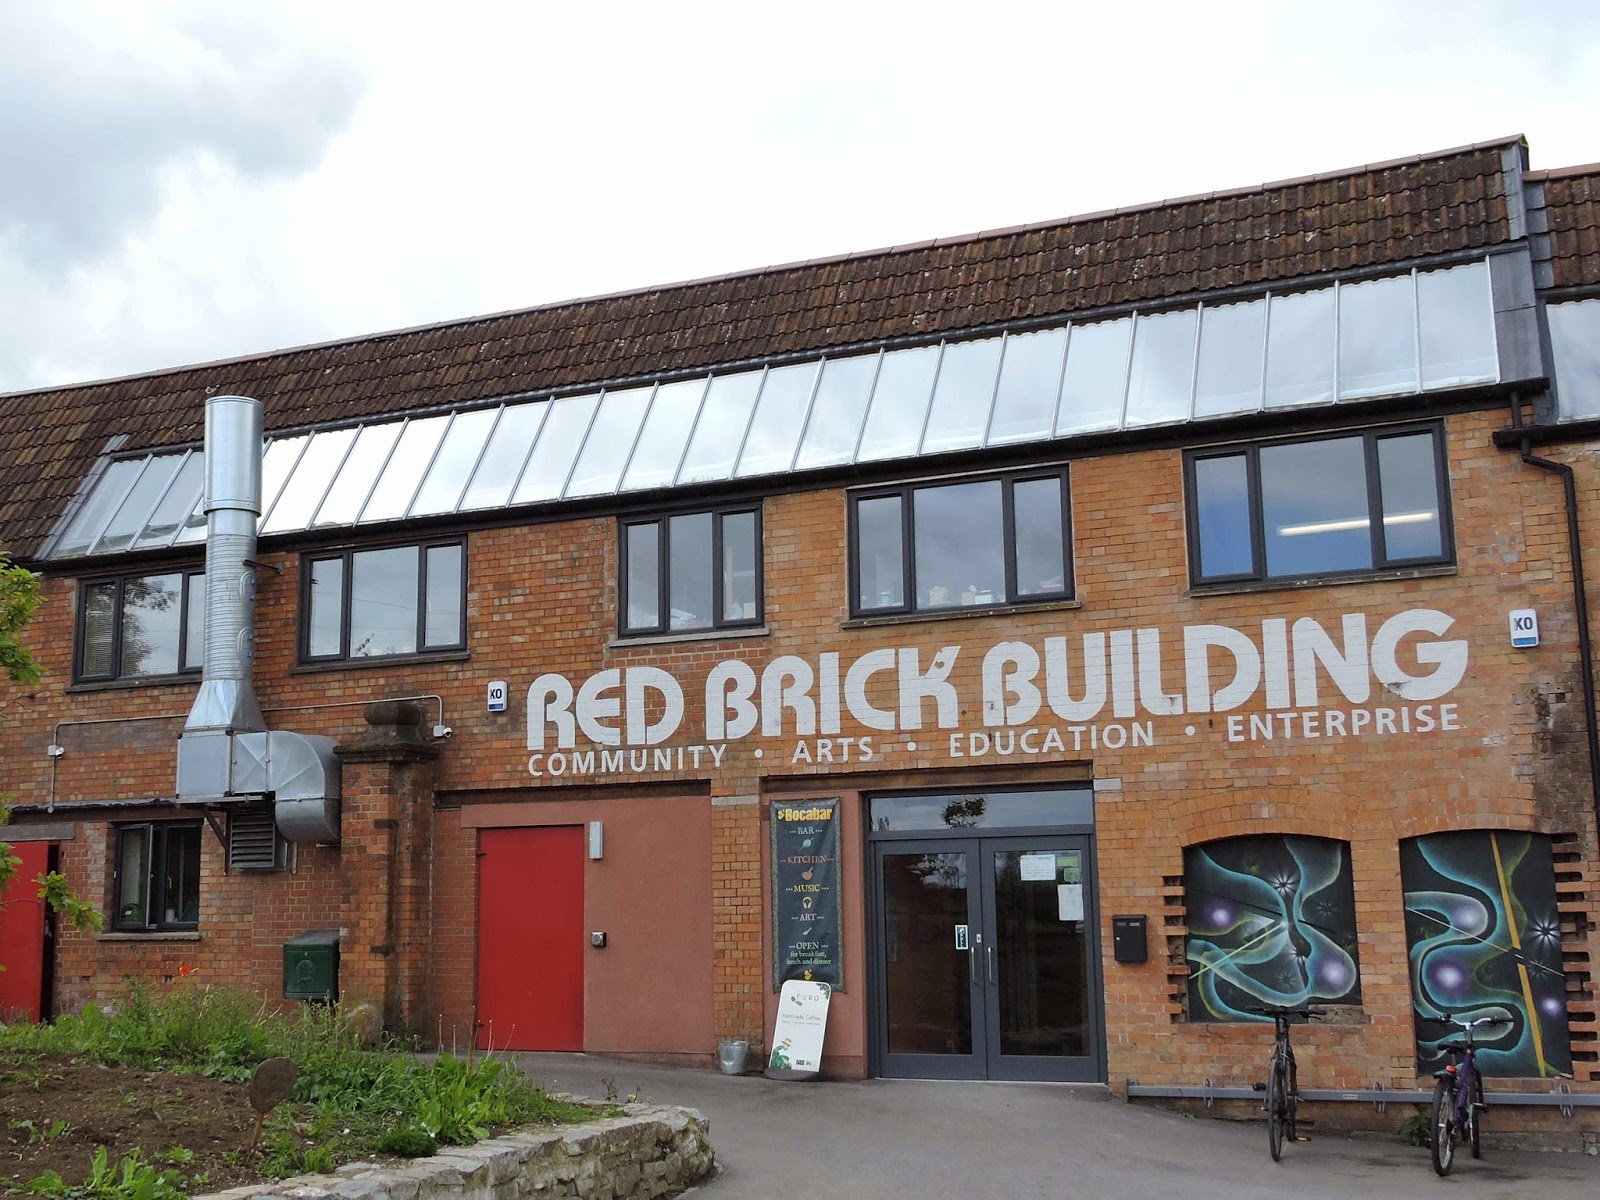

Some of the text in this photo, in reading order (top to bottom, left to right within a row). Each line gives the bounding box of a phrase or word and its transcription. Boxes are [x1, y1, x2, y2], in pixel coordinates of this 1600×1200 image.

[526, 609, 1469, 751] RED BRICK BUILDING
[528, 703, 1460, 777] COMMUNITY ARTS EDUCATION ENTERPRISE
[785, 807, 833, 822] Bocabar
[797, 826, 815, 835] BAR
[787, 855, 827, 864] KITCHEN
[793, 884, 820, 893] MUSIC
[799, 913, 817, 921] ART
[795, 941, 820, 950] OPEN
[796, 993, 820, 1002] PURO
